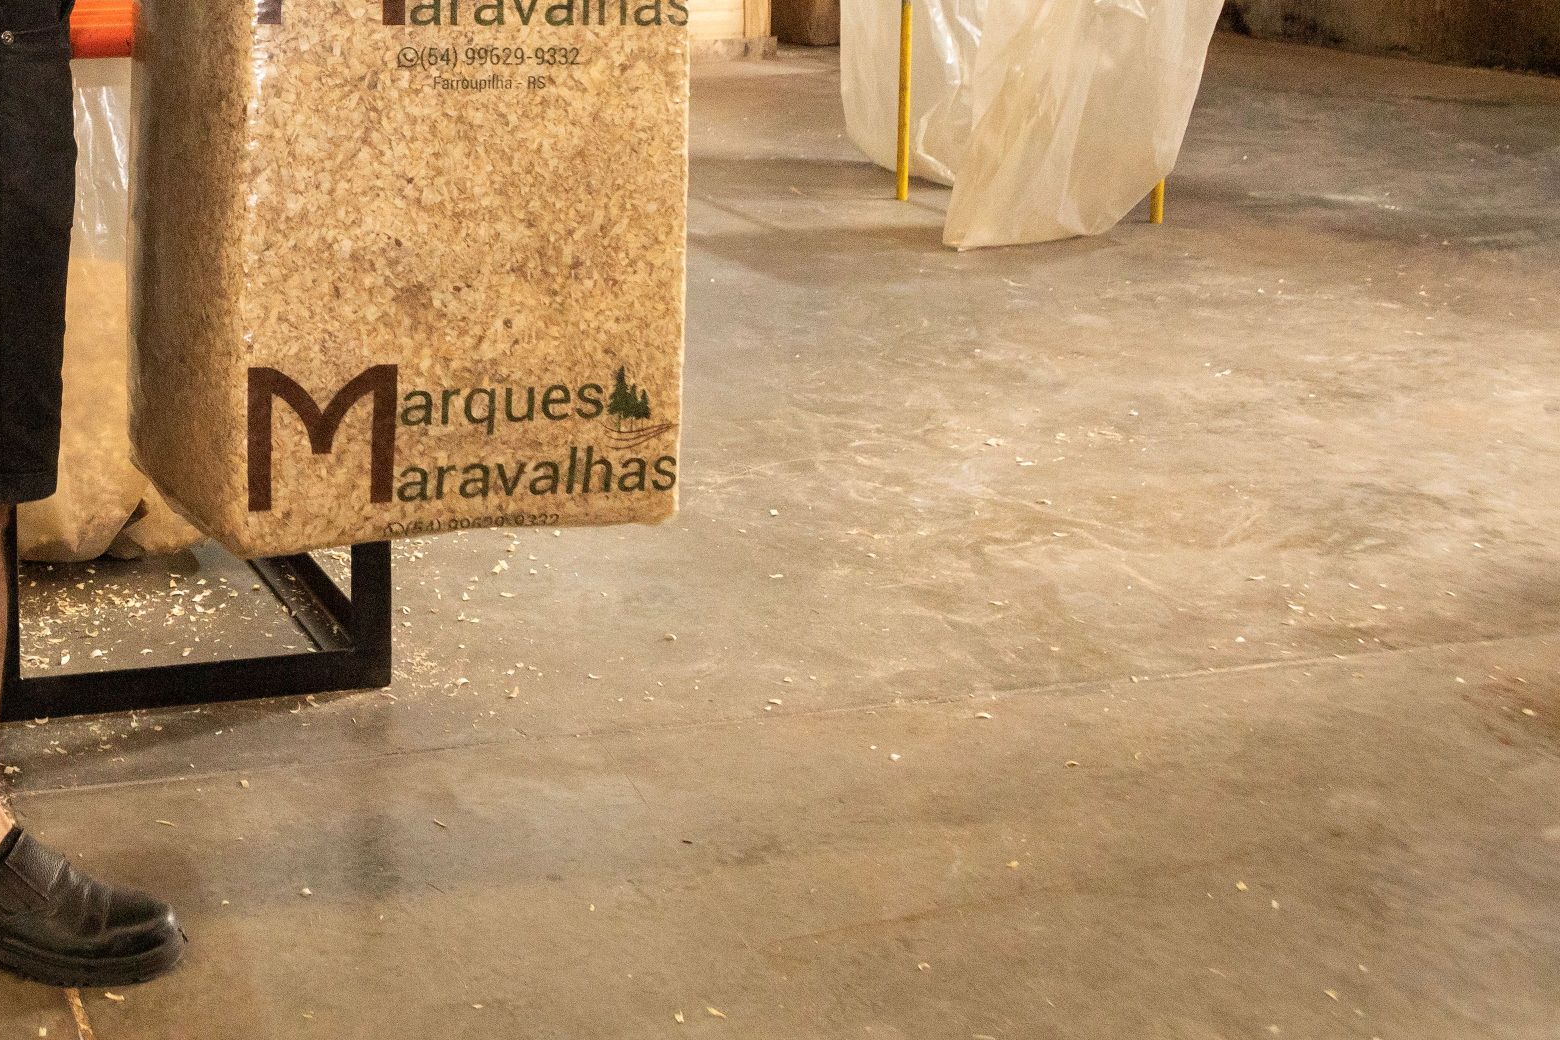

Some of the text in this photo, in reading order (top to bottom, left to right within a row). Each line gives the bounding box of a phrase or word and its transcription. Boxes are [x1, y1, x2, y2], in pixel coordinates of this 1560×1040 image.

[421, 46, 581, 71] (54) 99629-9332
[433, 74, 513, 93] Farroupilha
[527, 75, 547, 90] RS
